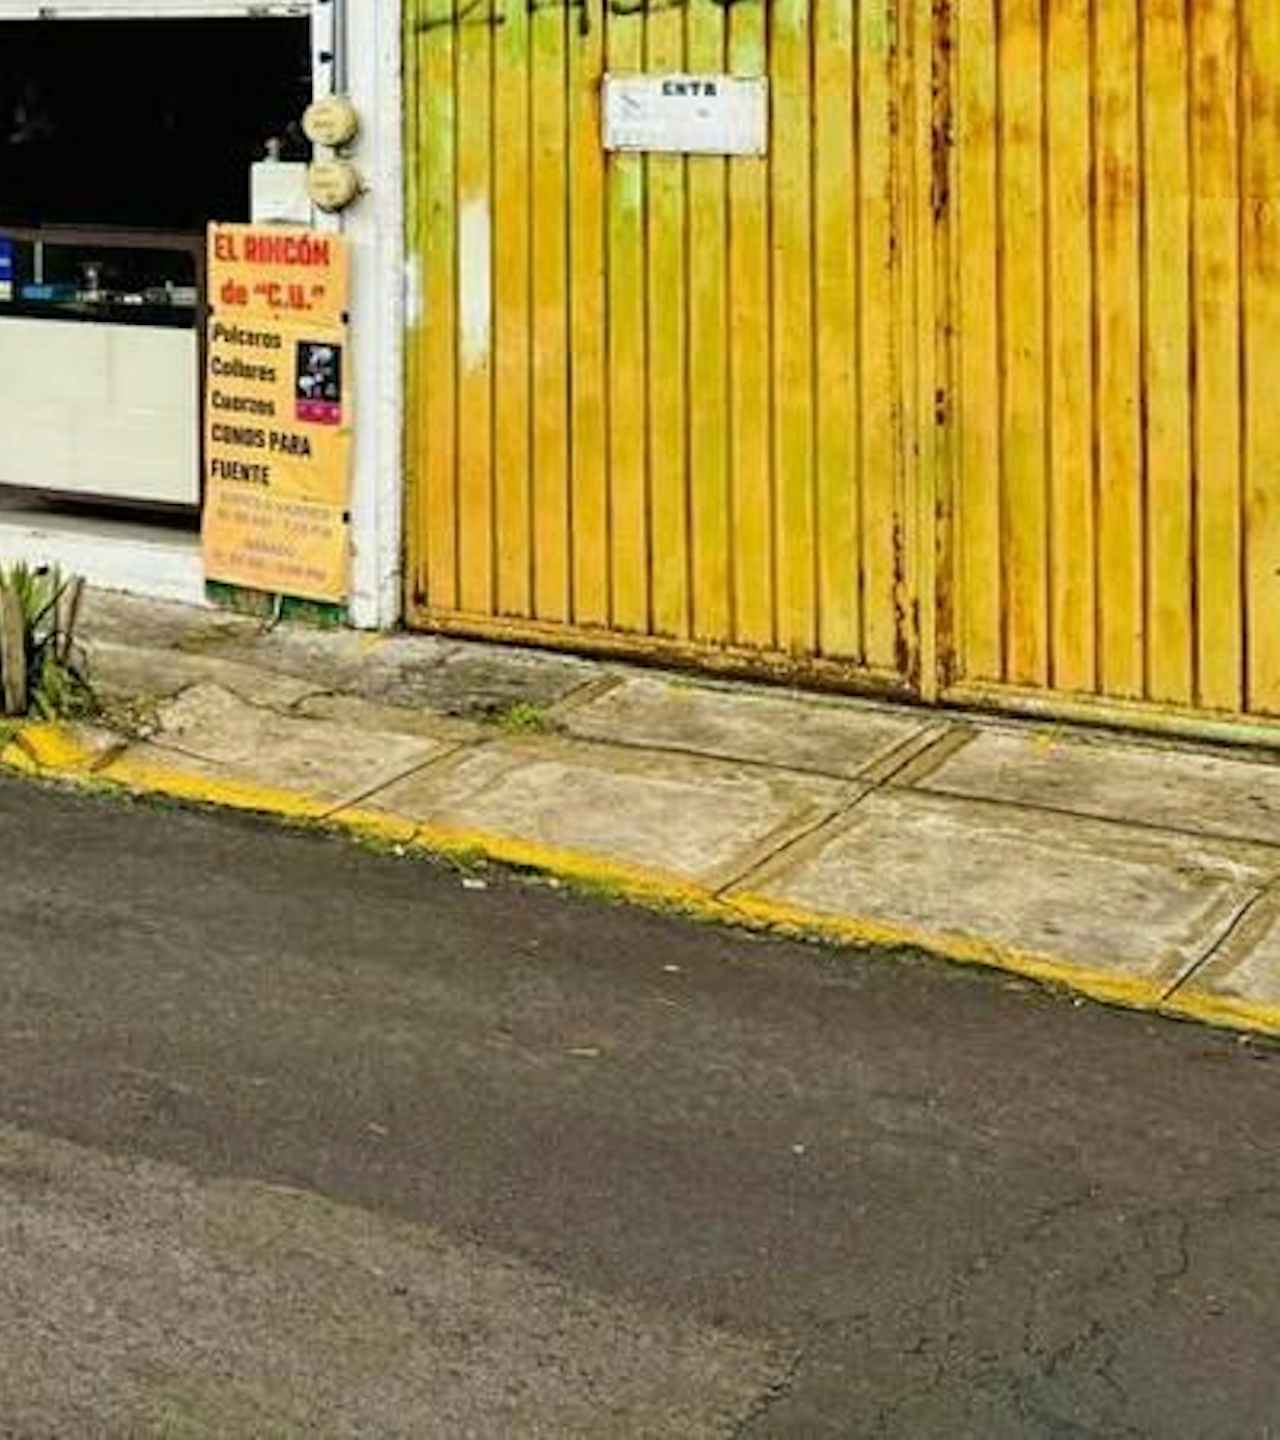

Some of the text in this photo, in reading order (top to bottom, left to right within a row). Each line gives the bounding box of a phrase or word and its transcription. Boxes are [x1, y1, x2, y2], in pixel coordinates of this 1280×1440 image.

[215, 233, 238, 262] EL
[221, 277, 248, 306] de
[268, 430, 310, 456] PARA
[211, 458, 270, 487] FUENTE
